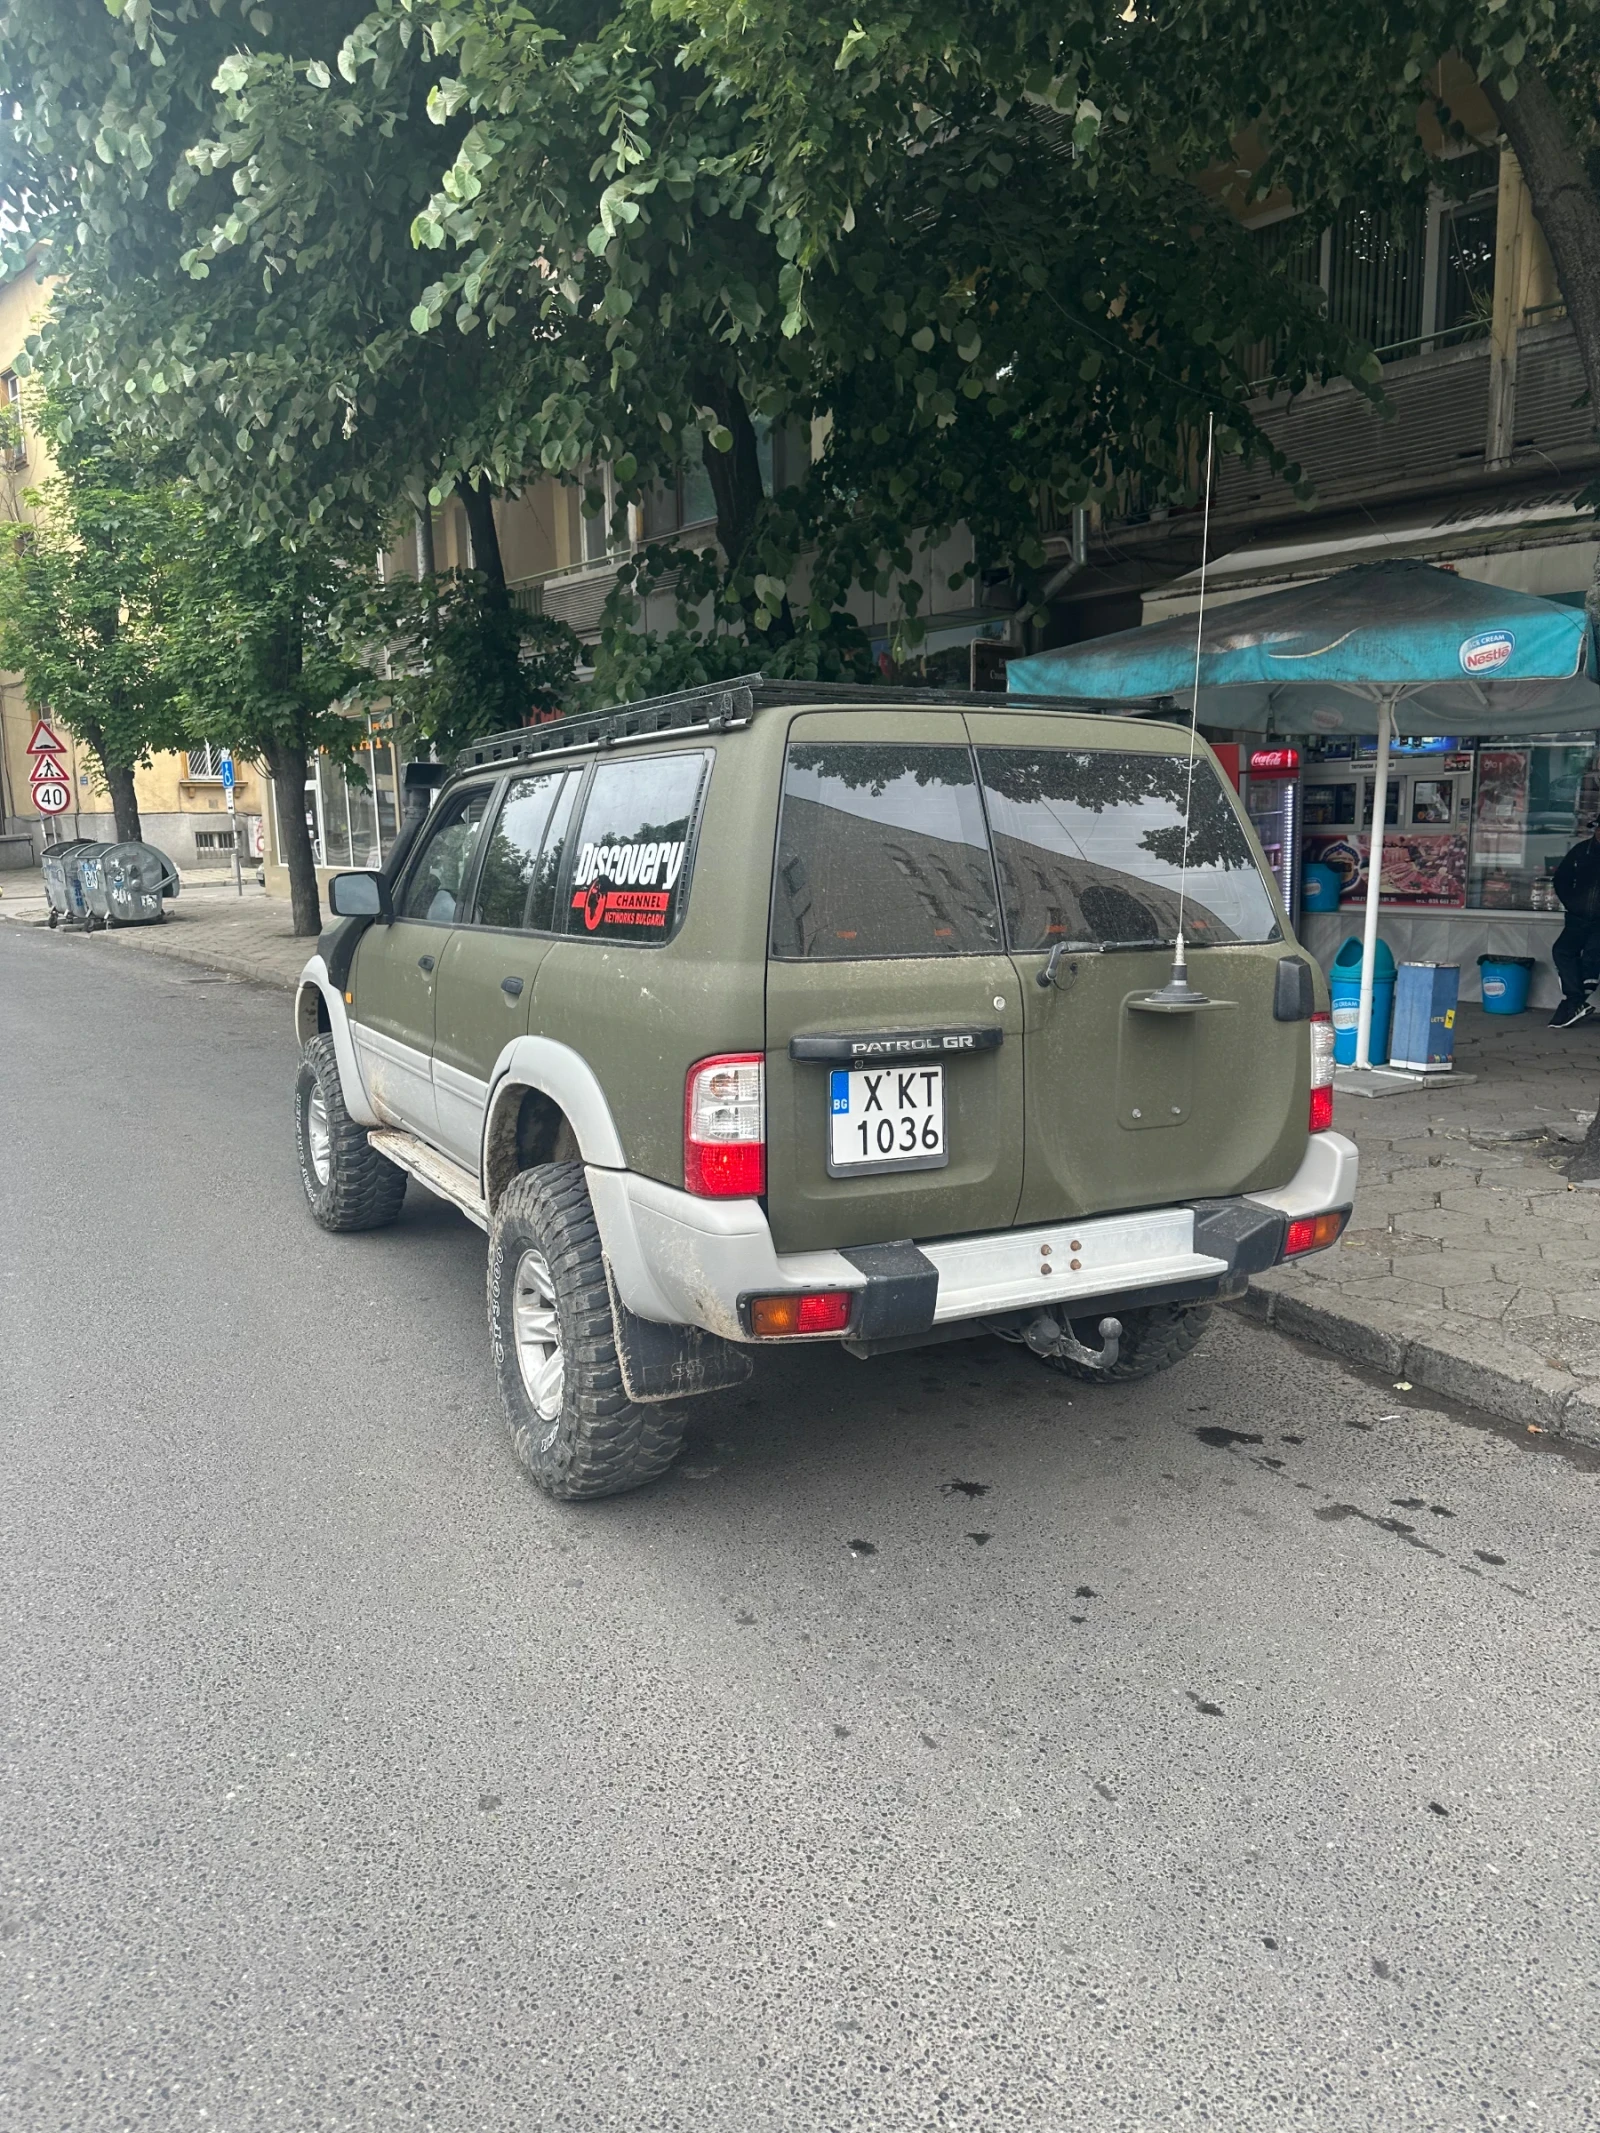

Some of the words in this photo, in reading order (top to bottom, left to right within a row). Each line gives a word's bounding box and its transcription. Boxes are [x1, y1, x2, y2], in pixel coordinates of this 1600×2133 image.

[1481, 634, 1505, 645] CREAM
[41, 788, 62, 806] 40
[616, 895, 662, 908] CHANNEL
[604, 911, 635, 925] NETWORKS
[635, 912, 665, 927] BULGARIA
[852, 1038, 940, 1054] PATROL
[943, 1035, 974, 1049] GR
[833, 1098, 848, 1110] BG
[857, 1114, 940, 1155] 1036
